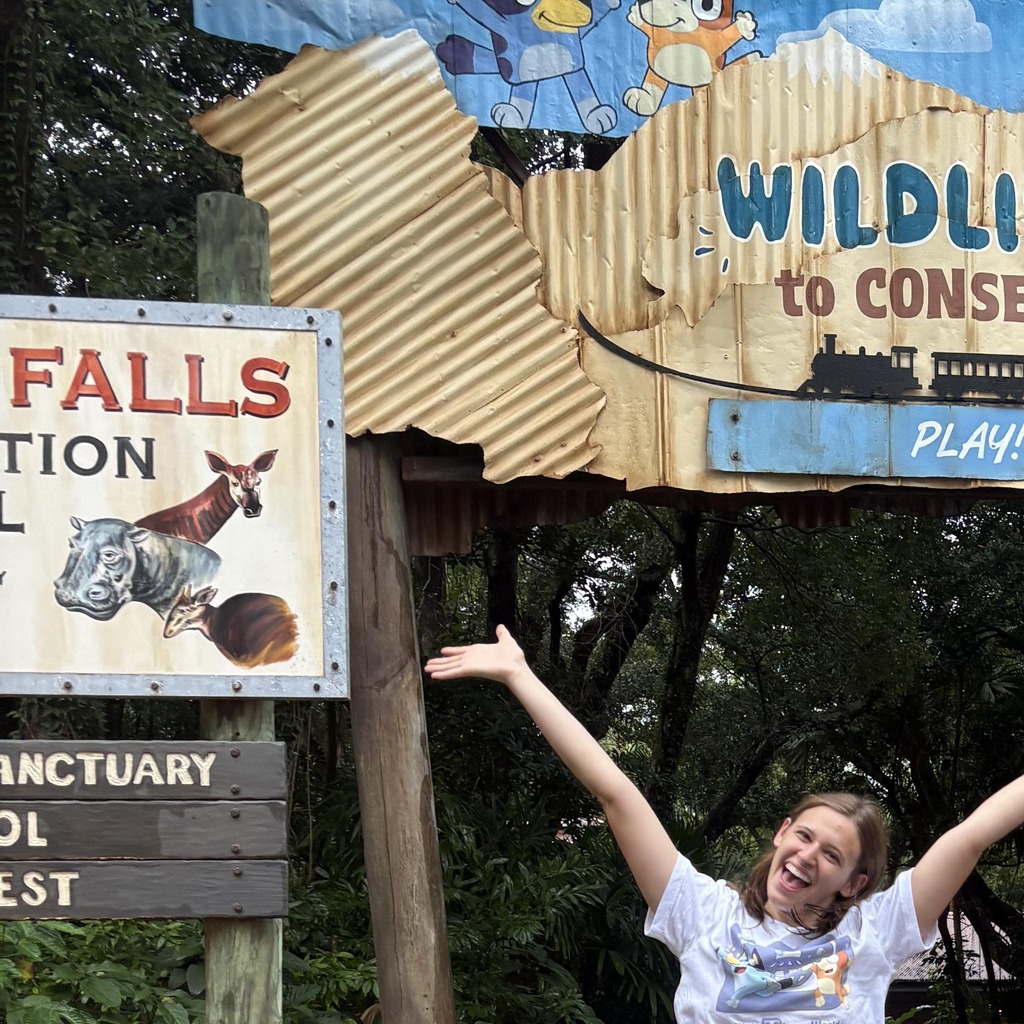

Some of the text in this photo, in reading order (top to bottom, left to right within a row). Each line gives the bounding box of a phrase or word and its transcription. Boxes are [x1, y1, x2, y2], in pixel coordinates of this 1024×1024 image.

[774, 269, 835, 316] to
[9, 346, 290, 419] FALLS
[0, 432, 156, 479] TION
[0, 871, 79, 907] EST
